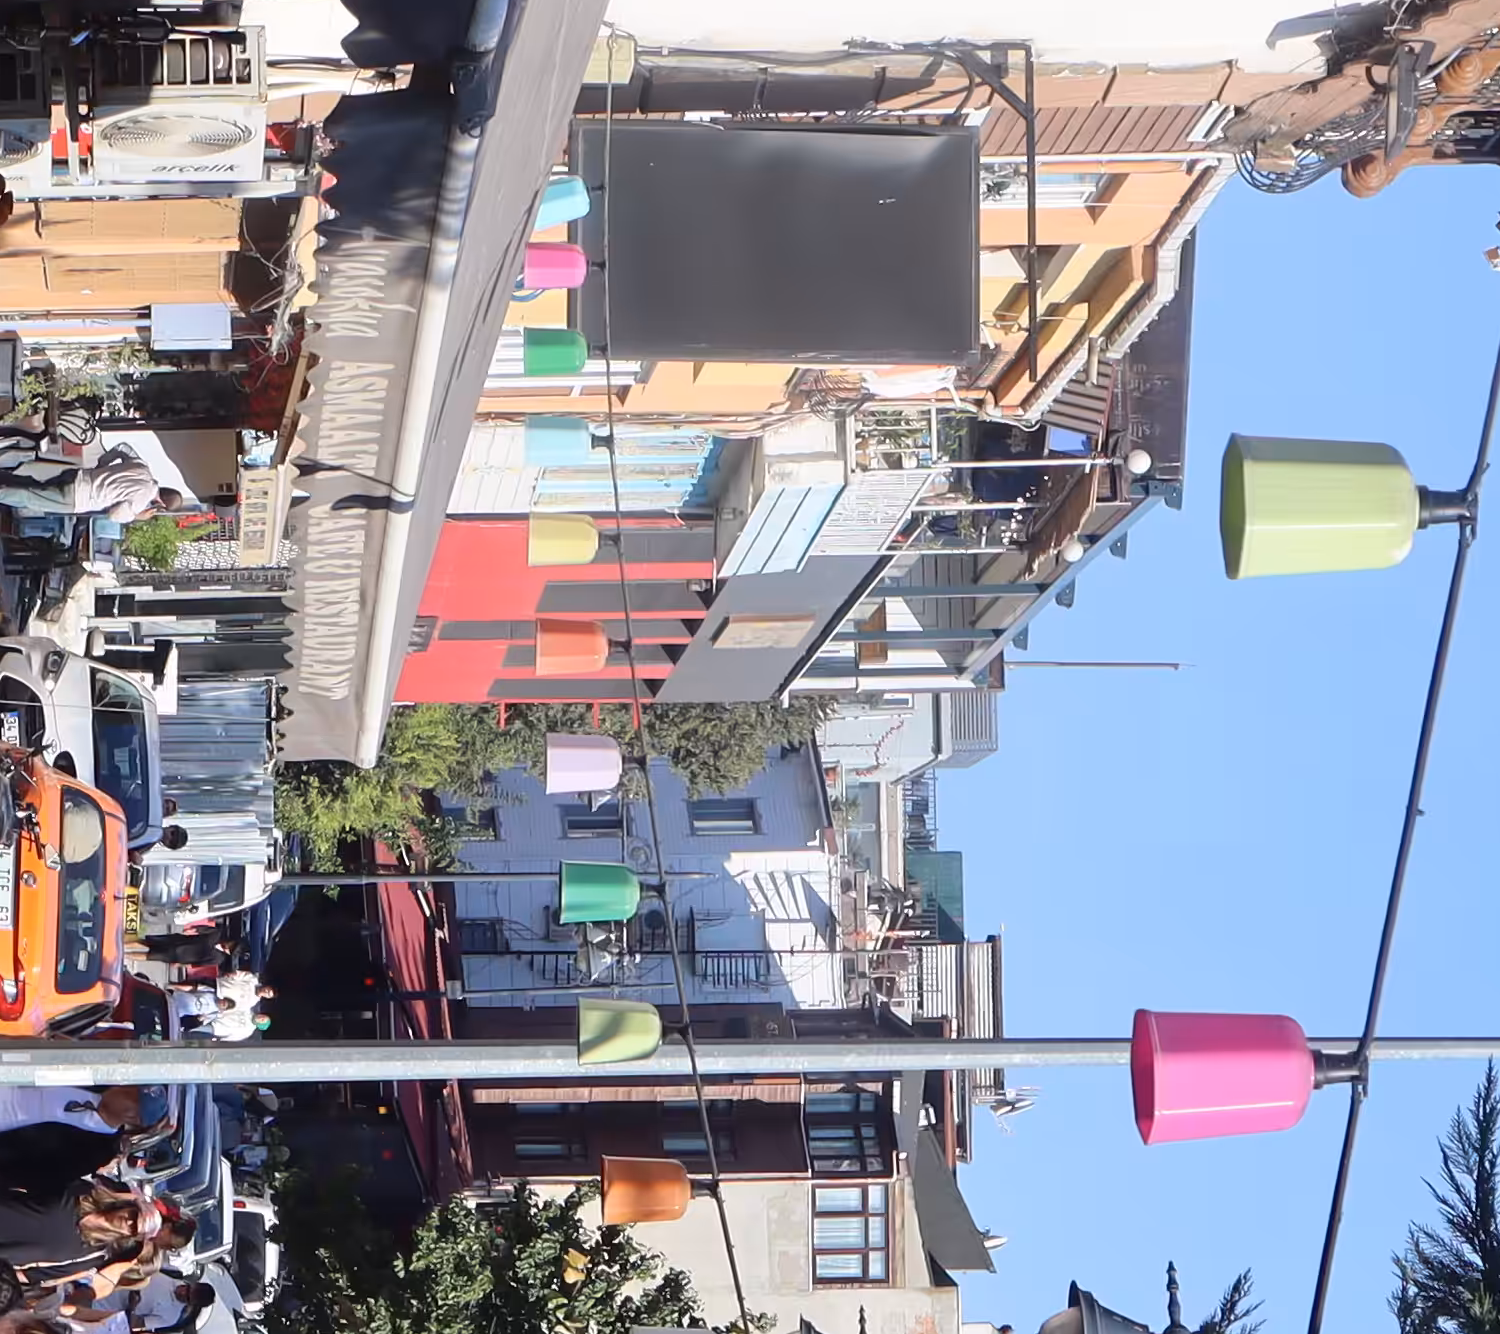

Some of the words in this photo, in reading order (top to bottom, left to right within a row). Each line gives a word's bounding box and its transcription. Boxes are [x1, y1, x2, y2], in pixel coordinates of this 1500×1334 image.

[307, 503, 366, 557] CAFE
[298, 577, 360, 700] RESTAURANT
[6, 718, 17, 731] 34
